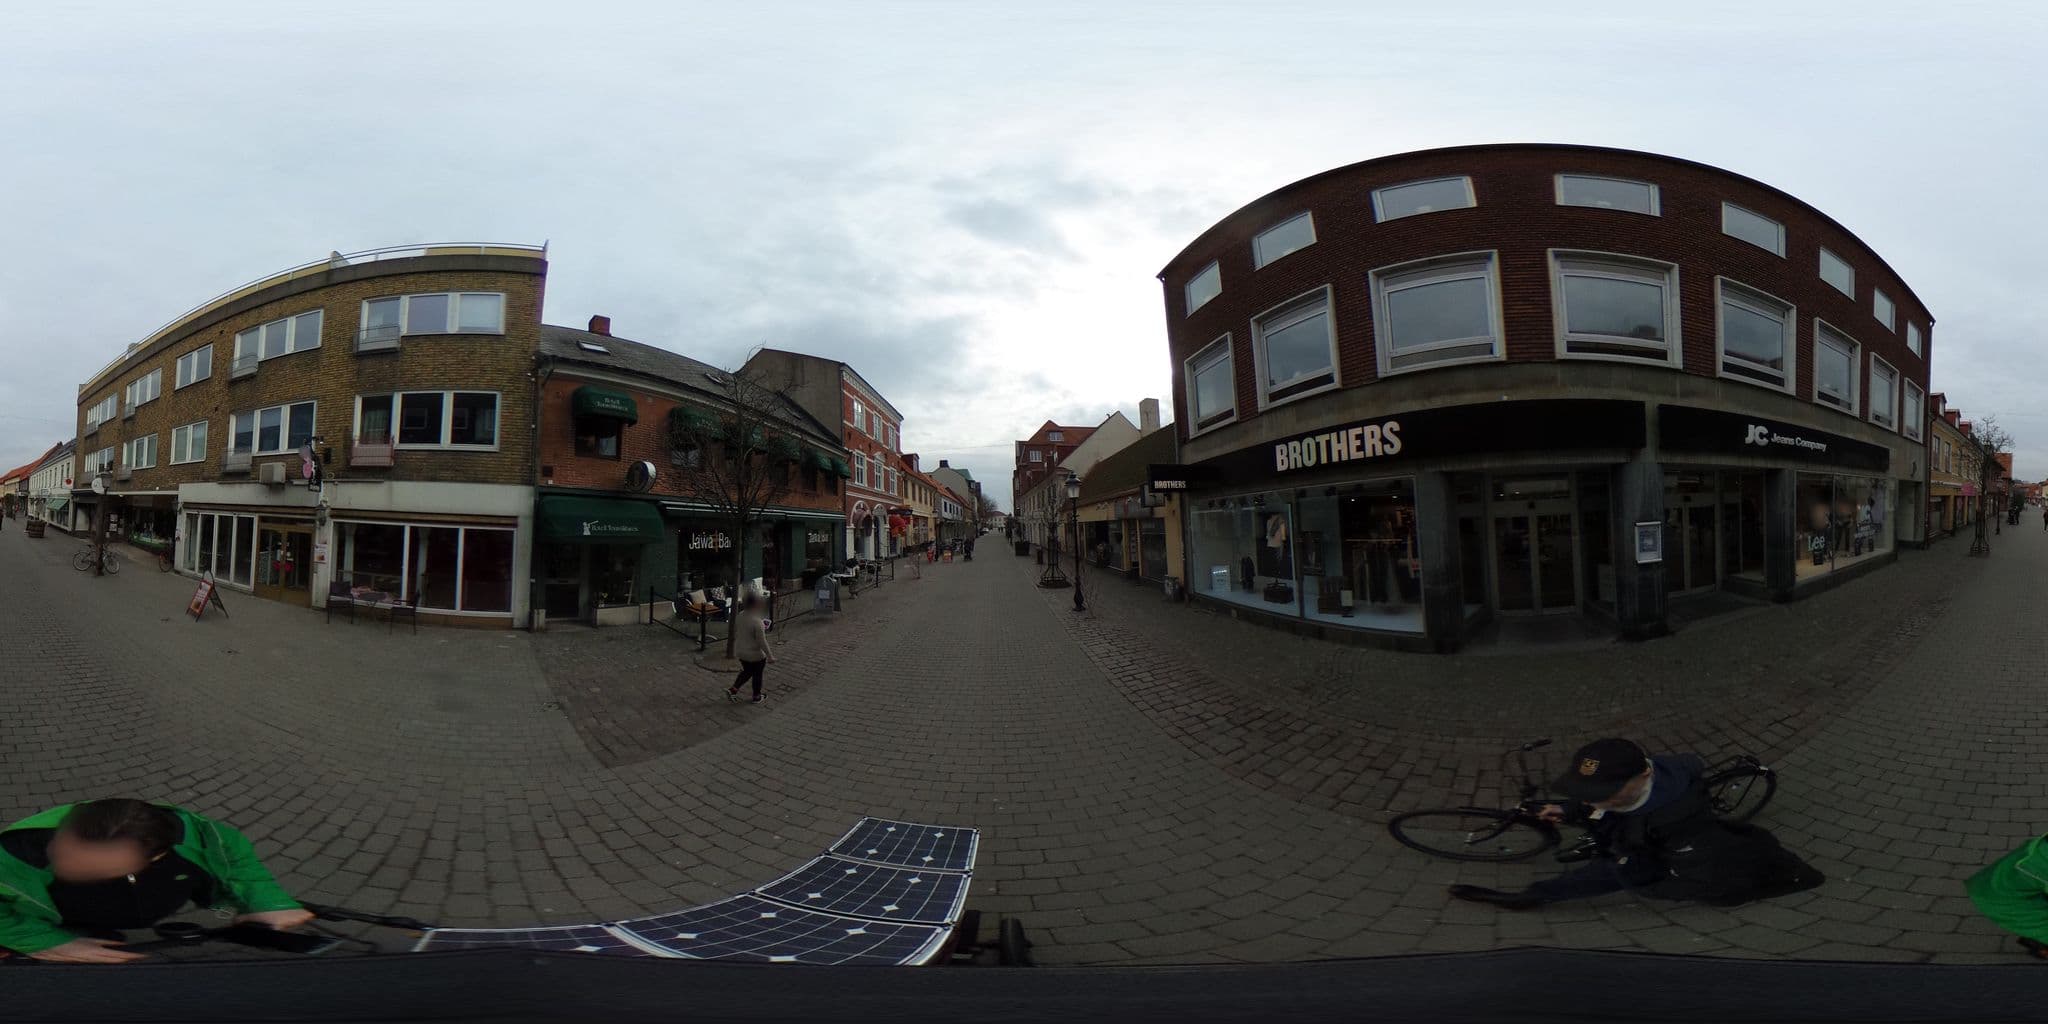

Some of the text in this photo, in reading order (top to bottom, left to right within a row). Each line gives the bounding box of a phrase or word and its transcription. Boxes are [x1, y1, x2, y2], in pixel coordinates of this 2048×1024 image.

[1275, 420, 1402, 472] BROTHERS
[1745, 424, 1827, 452] JC Jeans Company
[1154, 480, 1187, 489] BROTHERS
[689, 532, 713, 549] Jawa
